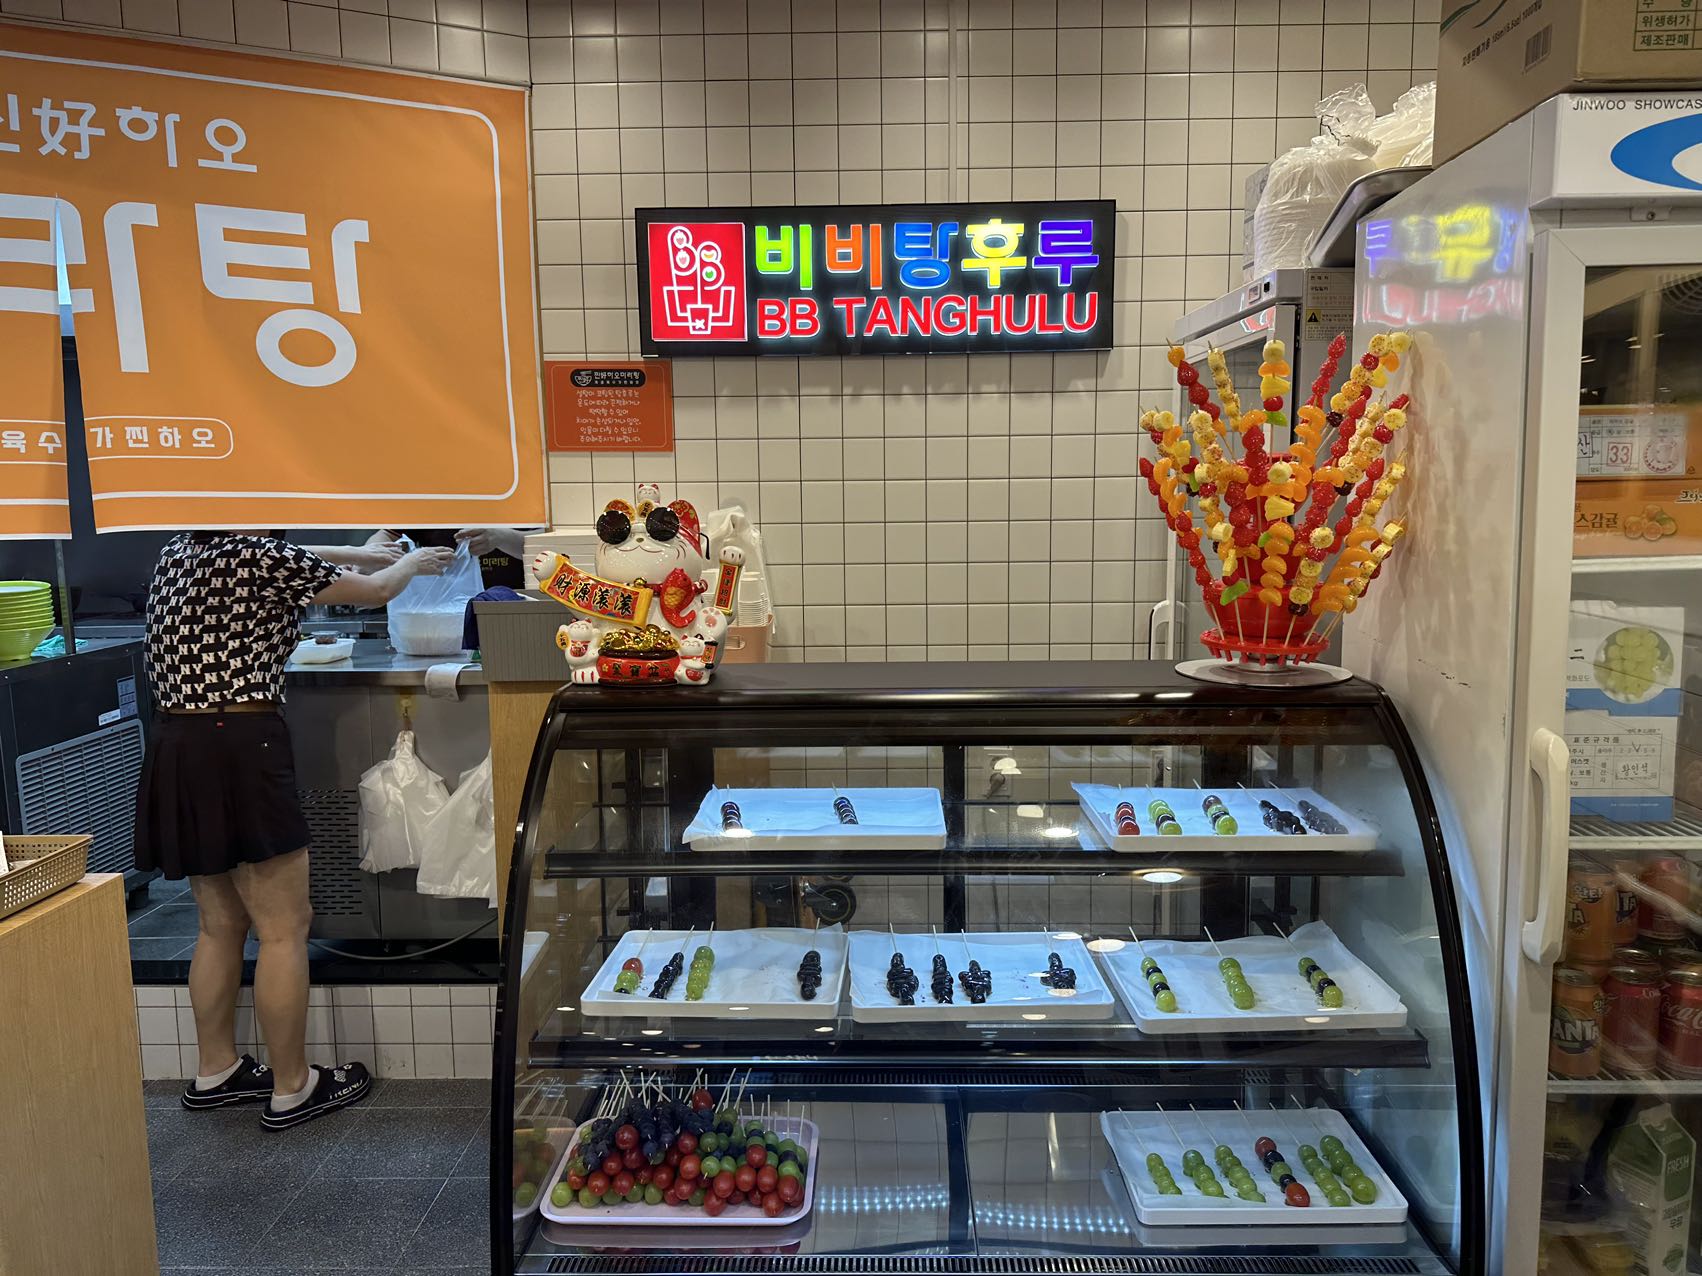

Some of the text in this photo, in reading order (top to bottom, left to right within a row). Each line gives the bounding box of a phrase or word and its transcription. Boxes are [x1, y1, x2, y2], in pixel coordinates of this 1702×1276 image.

[1642, 15, 1690, 27] 위생허가
[1640, 34, 1689, 47] 제조판매
[1573, 100, 1626, 111] JINWOO
[755, 218, 1100, 290] 비비탕후루
[757, 291, 1099, 338] BB TANGHULU
[1610, 445, 1630, 464] 33
[1576, 512, 1618, 528] 스감귤
[201, 550, 221, 558] NY
[241, 549, 265, 558] NY
[184, 559, 199, 569] NY
[215, 558, 239, 568] NY
[168, 568, 183, 578] NY
[195, 569, 213, 578] NY
[237, 568, 259, 578] NY
[177, 578, 192, 587] NY
[211, 578, 237, 588] NY
[188, 587, 209, 597] NY
[170, 596, 186, 606] NY
[207, 597, 234, 605] NY
[298, 591, 316, 608] NY
[182, 605, 205, 615] NY
[233, 602, 260, 613] NY
[165, 615, 181, 625] NY
[205, 614, 232, 625] NY
[179, 625, 202, 635] NY
[230, 620, 256, 632] NY
[163, 635, 179, 645] NY
[203, 633, 230, 643] NY
[228, 637, 254, 650] NY
[252, 641, 267, 651] NY
[179, 644, 200, 654] NY
[165, 654, 180, 664] NY
[202, 651, 228, 663] NY
[230, 654, 254, 669] NY
[262, 652, 276, 662] NY
[181, 664, 202, 674] NY
[205, 670, 232, 683] NY
[233, 672, 256, 687] NY
[256, 672, 271, 683] NY
[182, 684, 204, 694] NY
[207, 691, 232, 702] NY
[1667, 1154, 1690, 1174] FRESH
